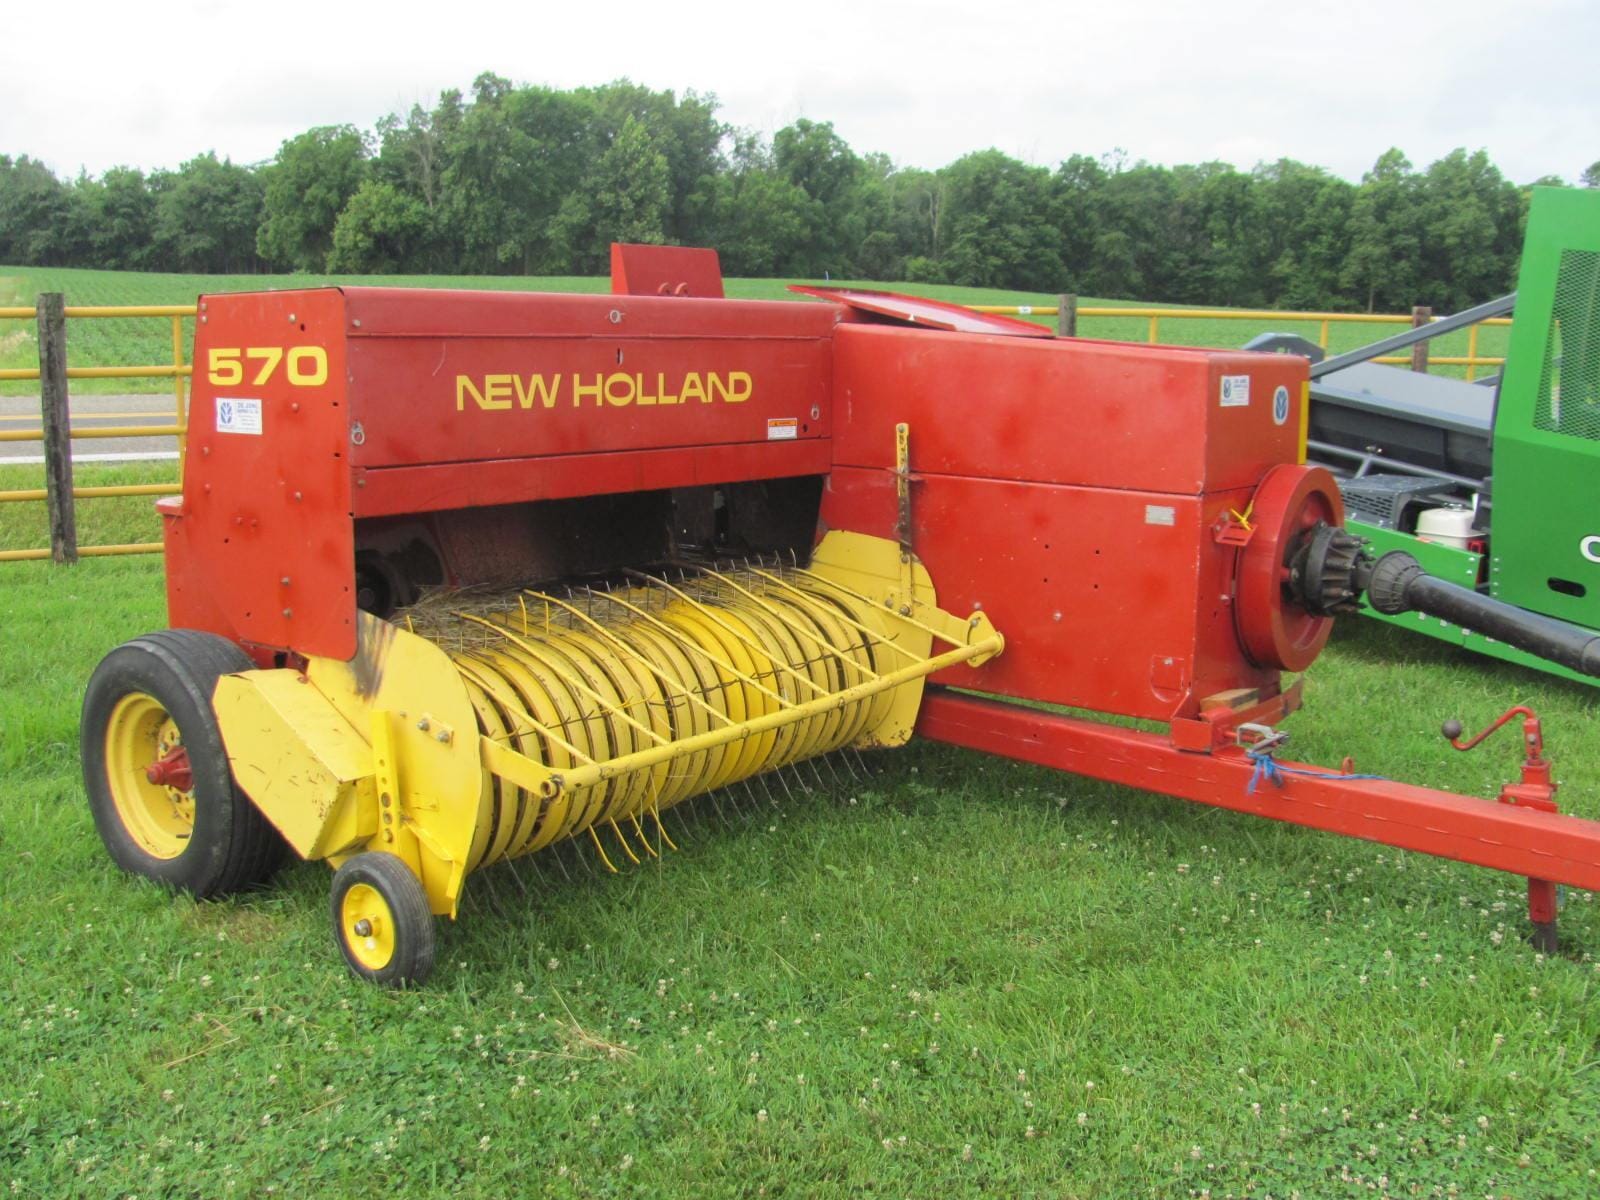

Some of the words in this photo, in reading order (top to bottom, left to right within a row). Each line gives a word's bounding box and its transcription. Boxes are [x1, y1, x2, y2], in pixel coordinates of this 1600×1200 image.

[208, 346, 328, 386] 570
[456, 374, 561, 411] NEW
[573, 371, 753, 407] HOLLAND
